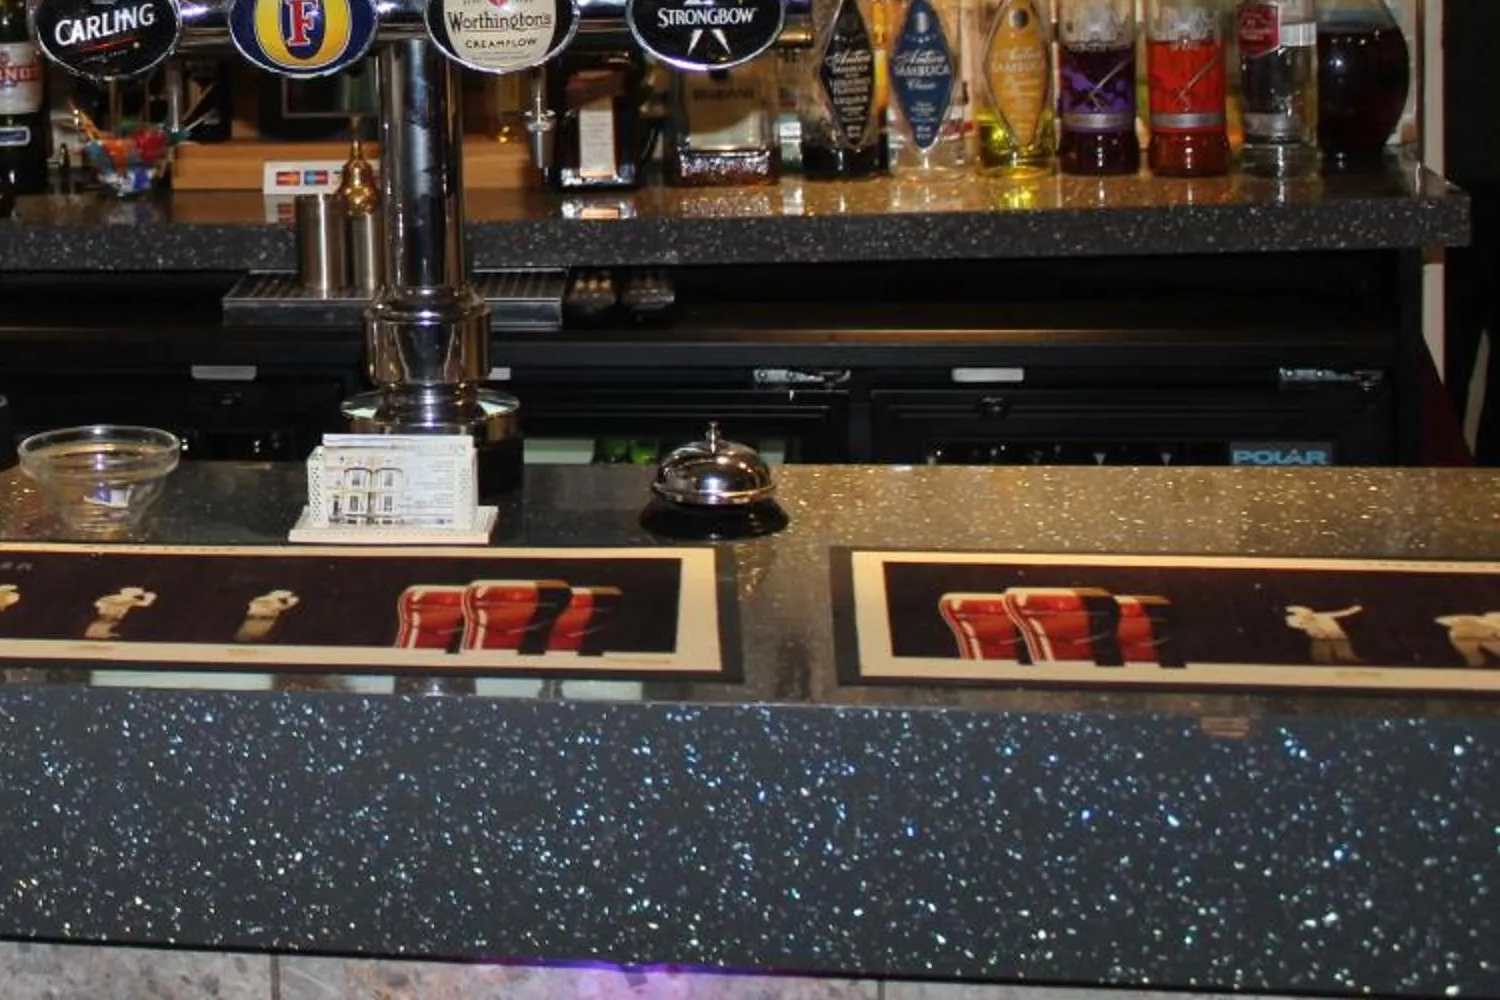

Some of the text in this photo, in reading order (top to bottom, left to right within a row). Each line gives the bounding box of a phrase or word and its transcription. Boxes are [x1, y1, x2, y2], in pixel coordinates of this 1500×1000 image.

[55, 3, 155, 46] CARLING
[446, 11, 552, 34] Worthington's
[657, 7, 758, 28] STRONGBOW
[464, 38, 538, 49] CREAMFLOW
[1231, 449, 1329, 466] POLAR
